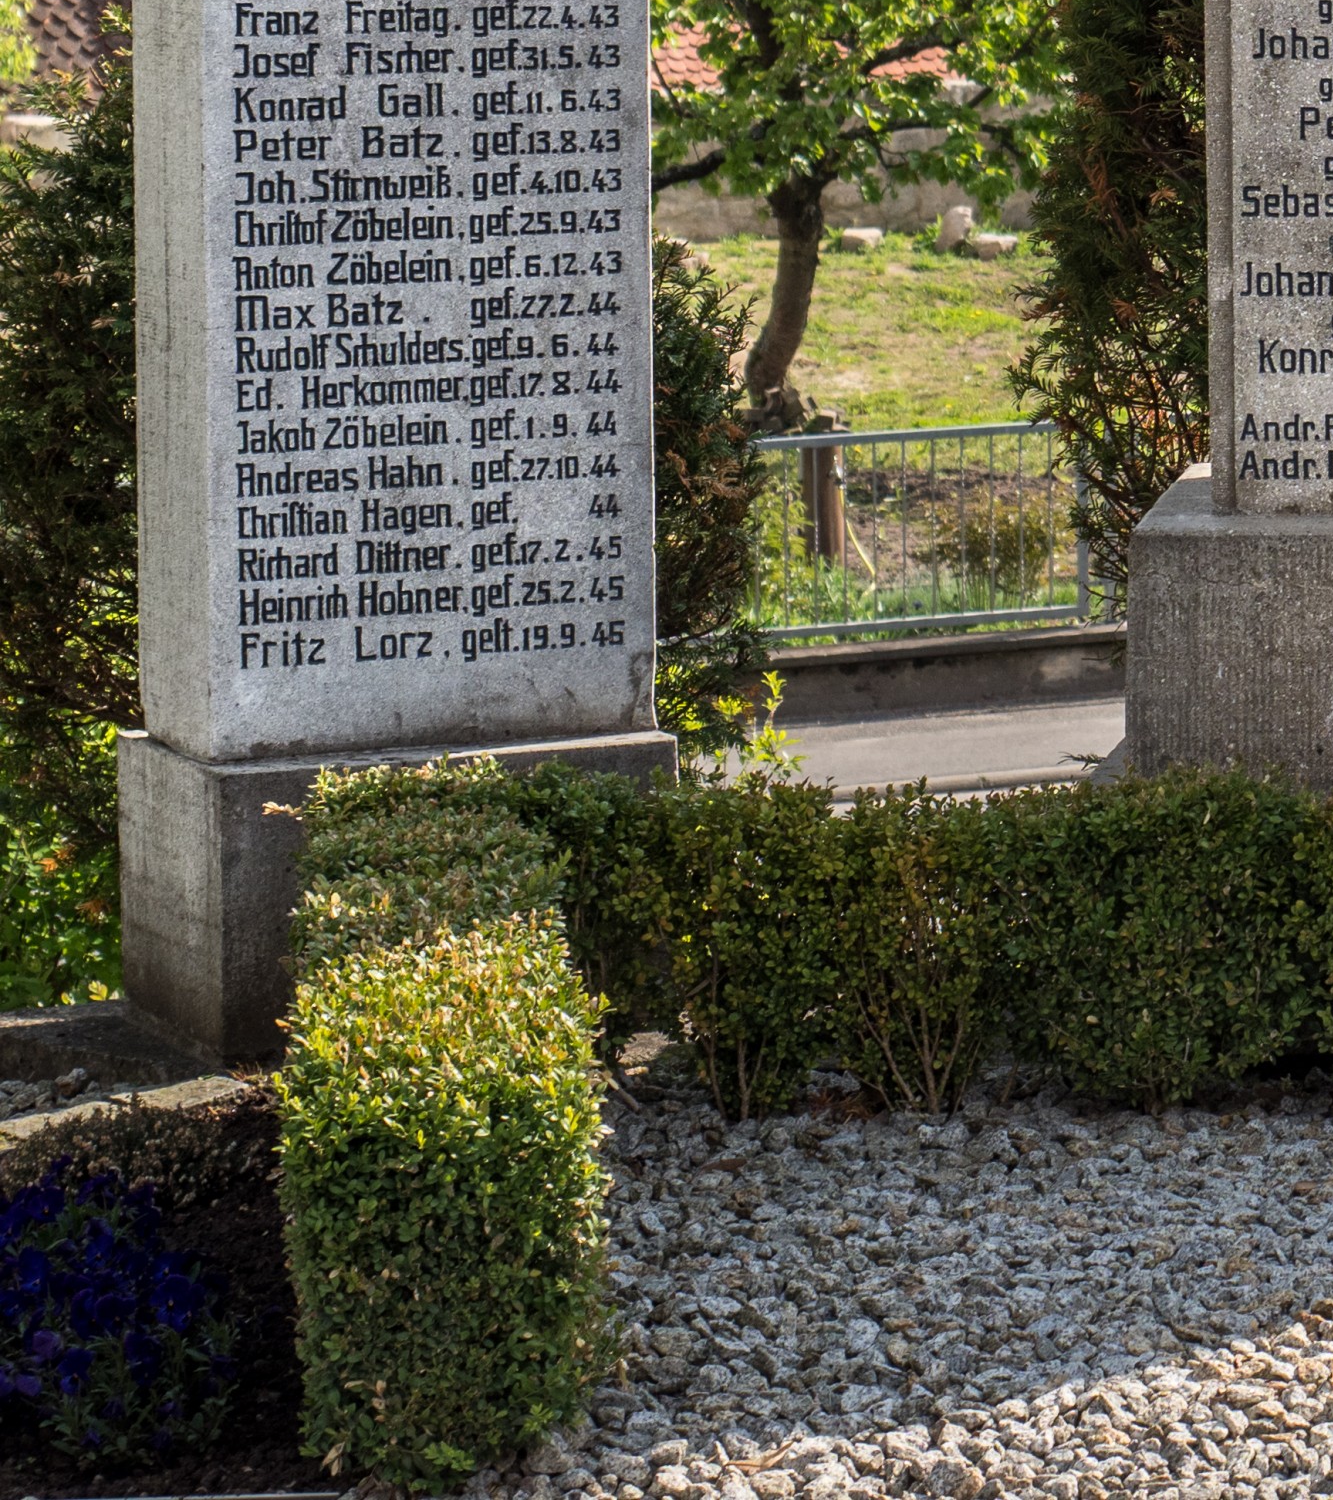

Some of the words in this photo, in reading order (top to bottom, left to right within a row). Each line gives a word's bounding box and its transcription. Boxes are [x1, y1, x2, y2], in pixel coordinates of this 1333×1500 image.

[236, 3, 318, 36] Franz
[234, 43, 321, 78] Josef
[234, 85, 346, 123] Konrad
[234, 130, 331, 163] Peter
[233, 256, 313, 291] Anton
[235, 295, 314, 332] Max
[236, 335, 330, 374] Rudolf
[237, 418, 315, 454] Jakob
[236, 463, 358, 497] Andreas
[241, 631, 325, 669] Fritz
